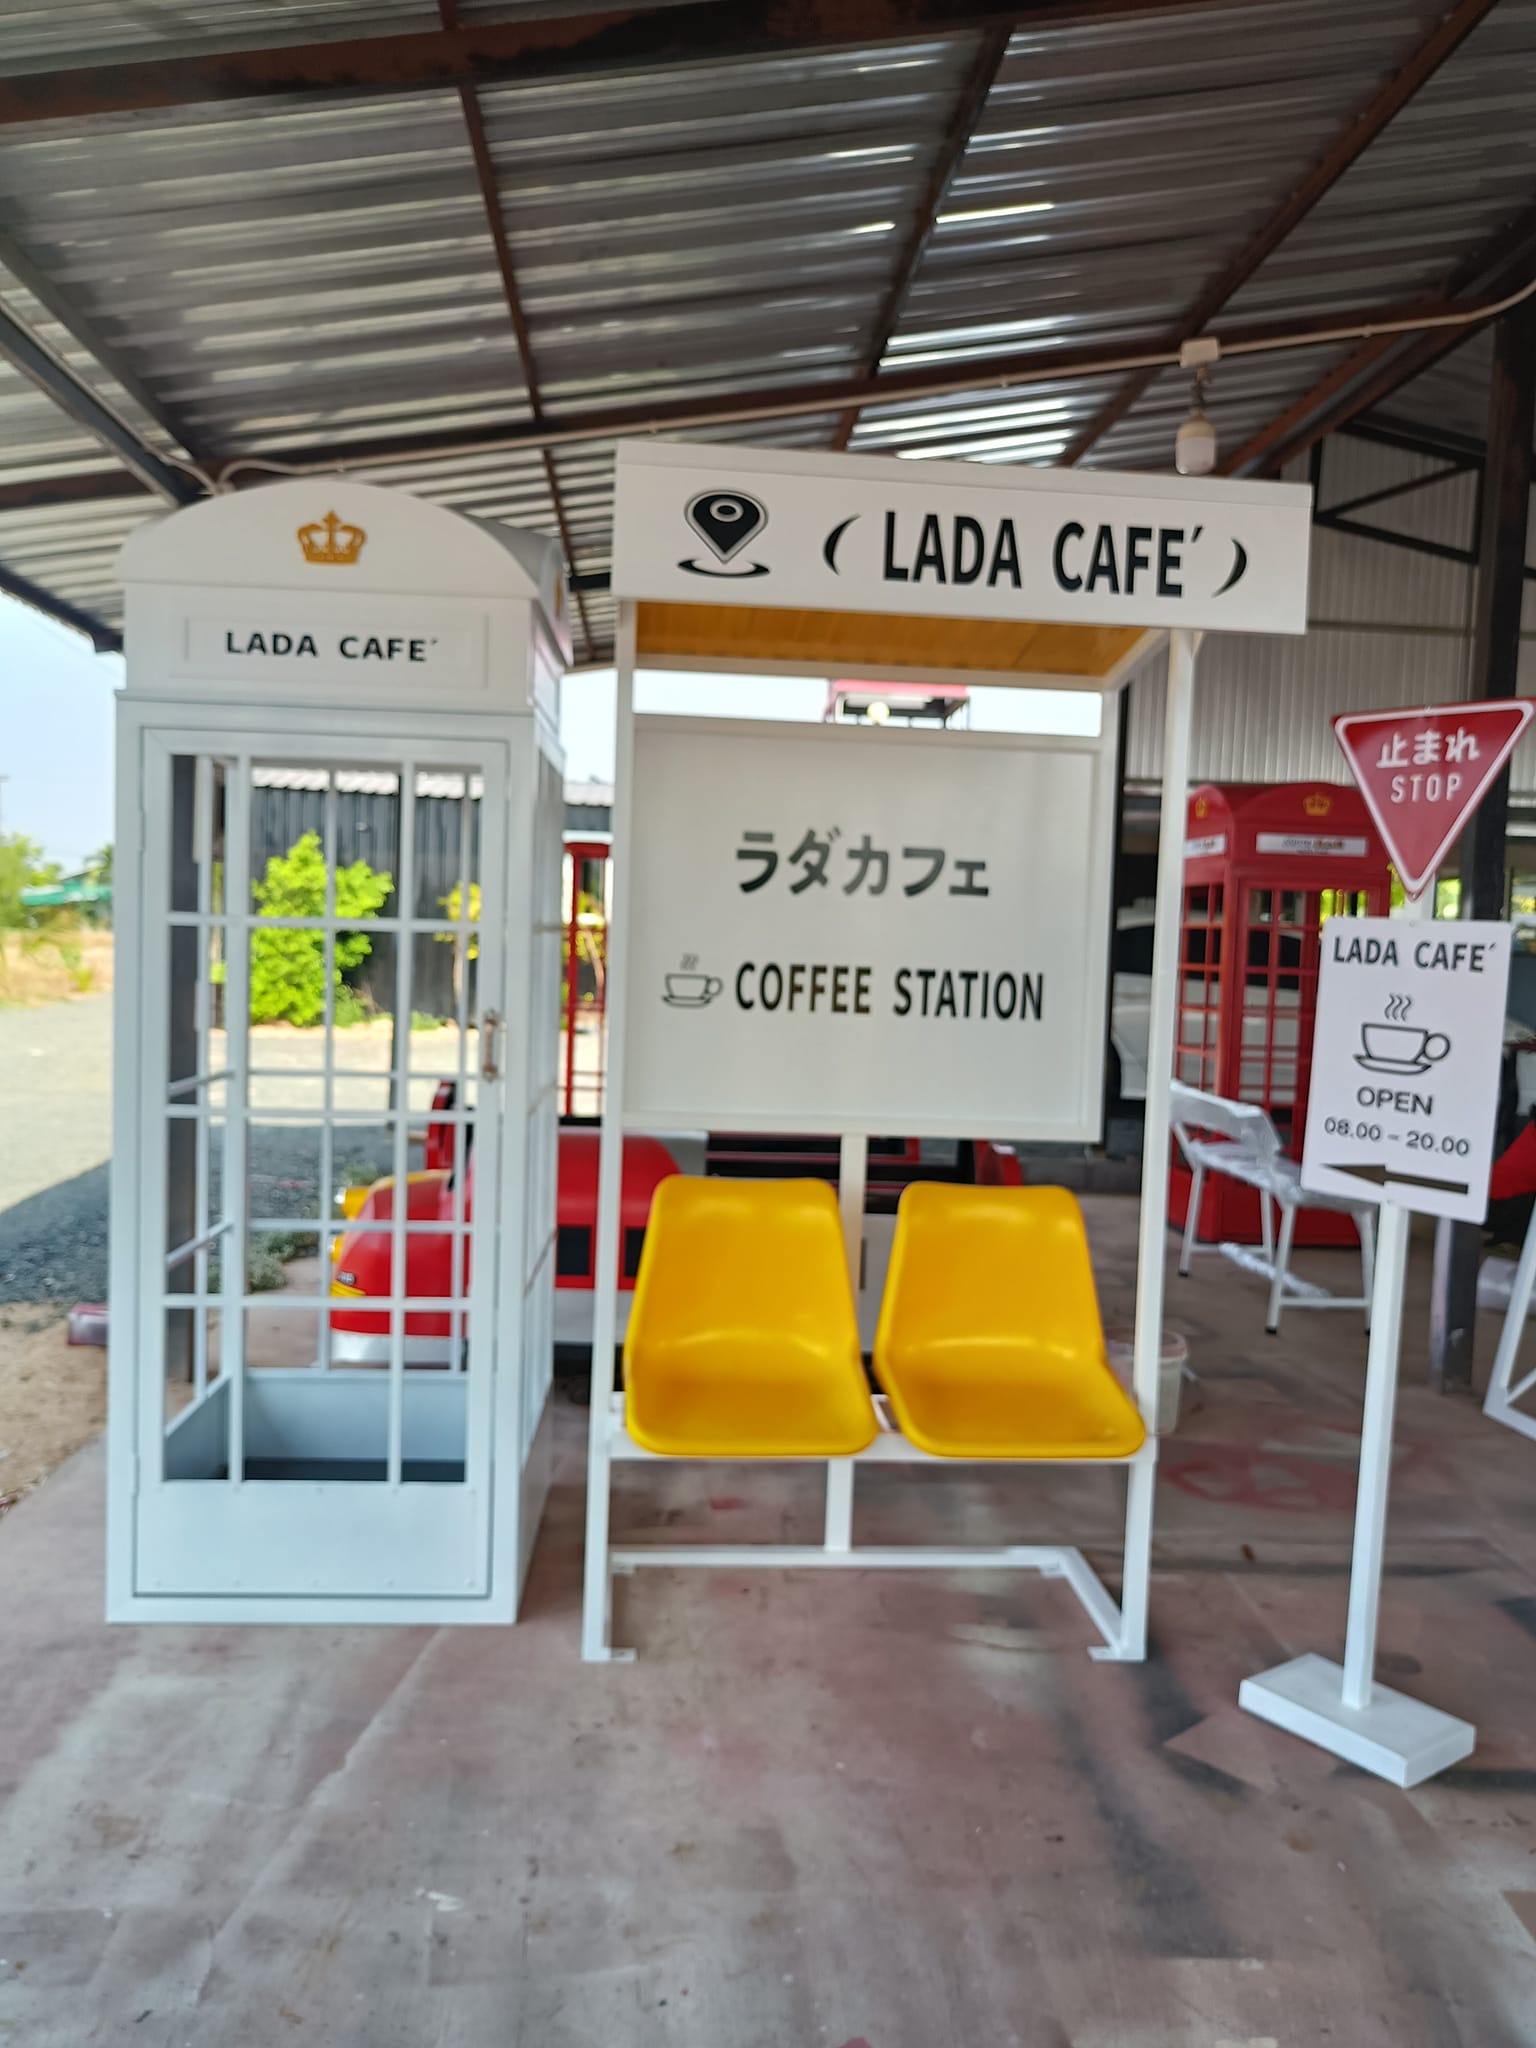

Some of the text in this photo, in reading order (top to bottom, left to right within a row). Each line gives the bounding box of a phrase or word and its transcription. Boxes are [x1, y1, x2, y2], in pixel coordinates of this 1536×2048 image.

[882, 511, 1022, 588] LADA
[225, 631, 319, 657] LADA
[1376, 727, 1480, 768] 止まれ
[1390, 773, 1463, 803] STOP
[736, 827, 990, 897] ラダカフェ
[1332, 934, 1399, 966] LADA
[735, 962, 1045, 1021] COFFEE STATION
[1356, 1085, 1433, 1116] OPEN
[1323, 1116, 1382, 1141] 08.00
[1405, 1130, 1470, 1156] 20.00
